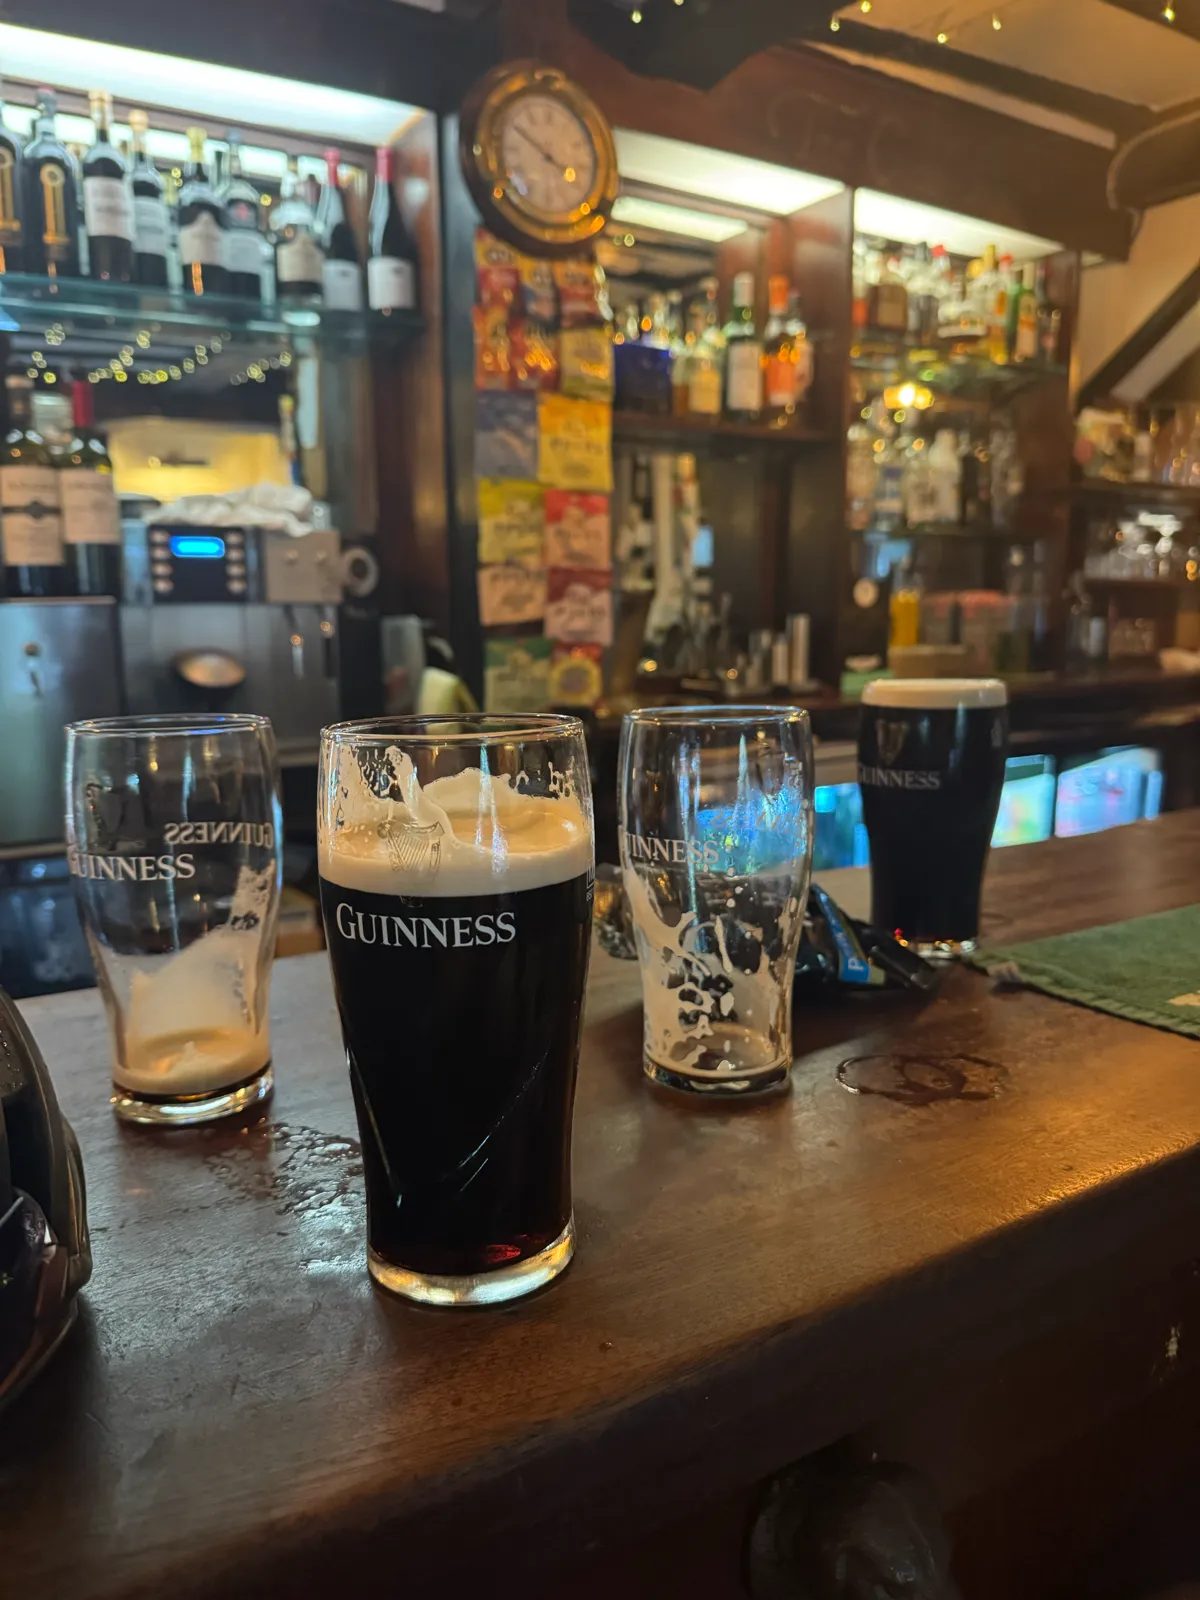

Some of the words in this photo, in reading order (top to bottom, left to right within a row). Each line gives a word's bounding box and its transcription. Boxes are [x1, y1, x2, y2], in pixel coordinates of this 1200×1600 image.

[858, 765, 941, 789] UINNESS
[618, 826, 719, 864] INNESS
[336, 902, 516, 948] GUINNESS
